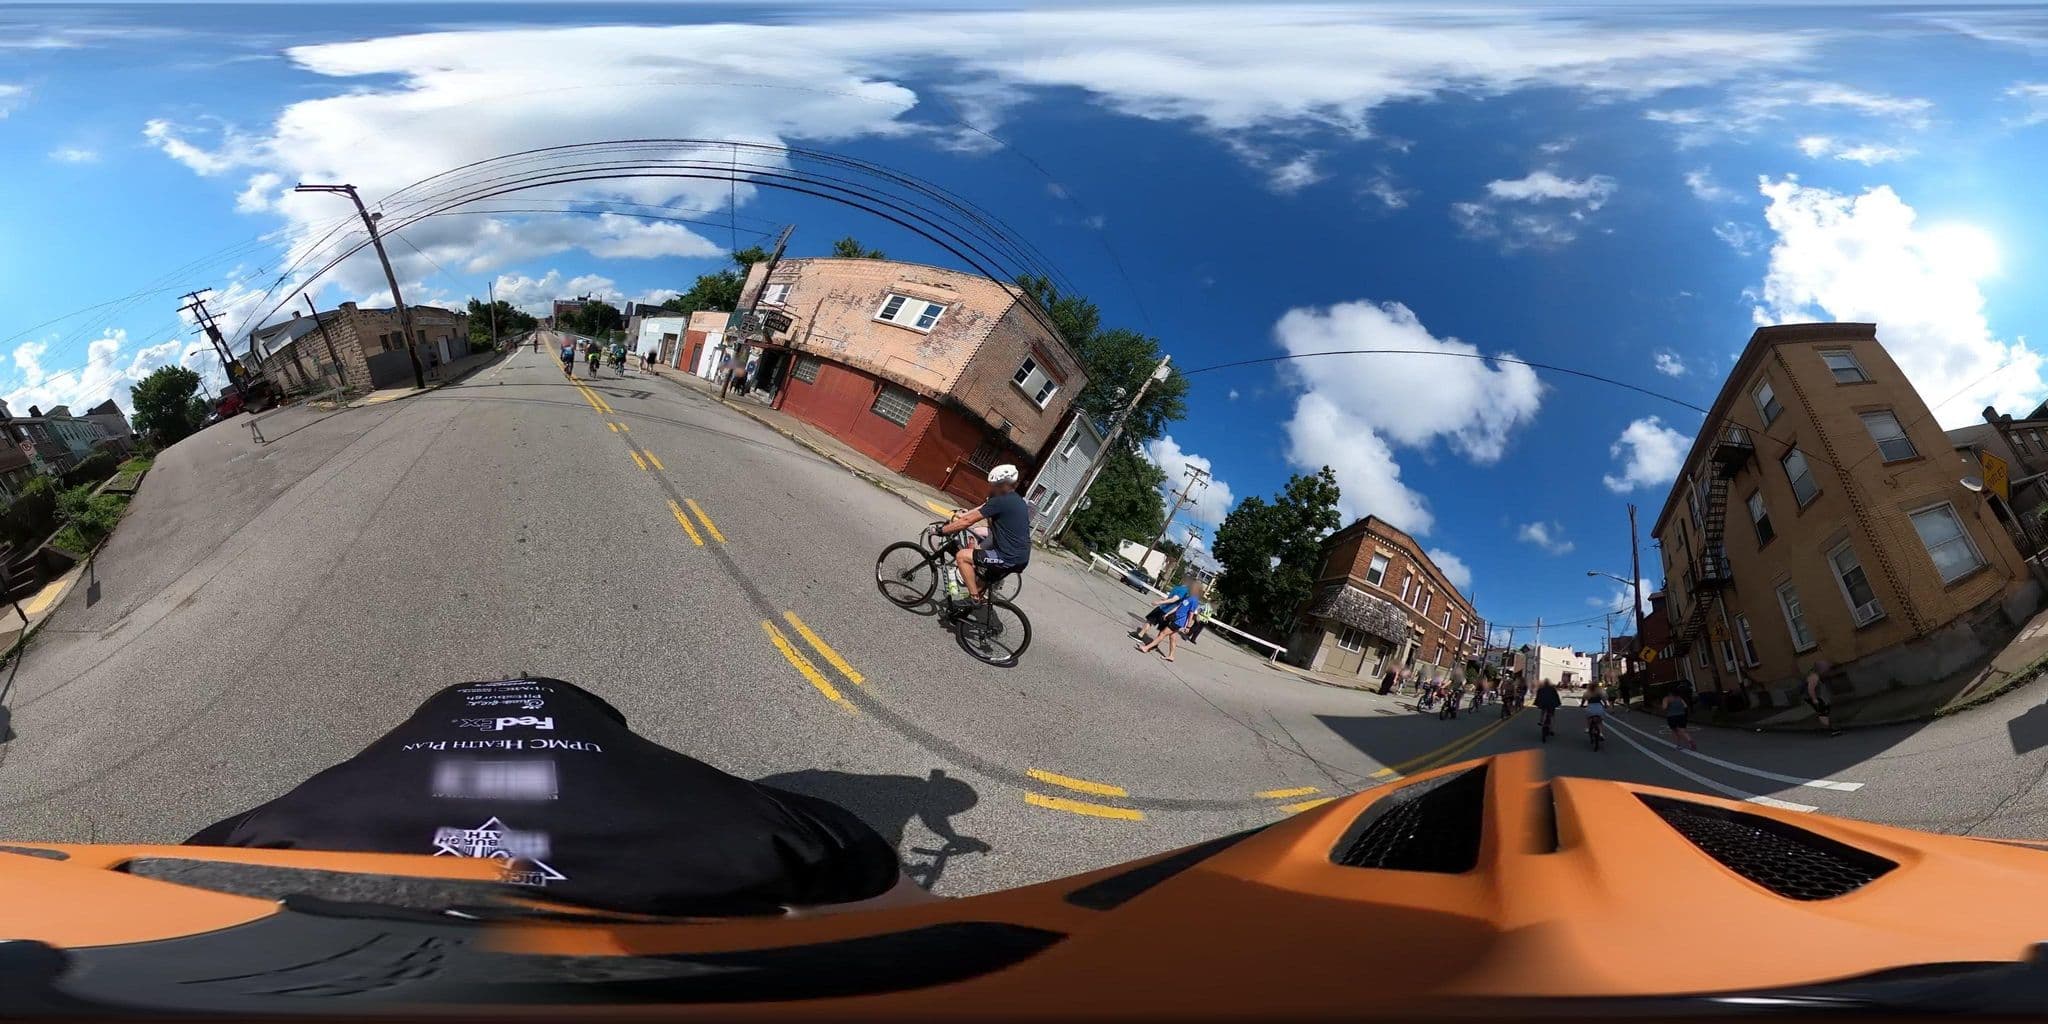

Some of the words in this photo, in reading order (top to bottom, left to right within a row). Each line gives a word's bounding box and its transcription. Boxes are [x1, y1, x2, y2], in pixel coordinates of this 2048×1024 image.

[742, 322, 755, 331] 25
[459, 716, 554, 731] FedEx
[402, 741, 447, 751] PLAN
[453, 739, 523, 750] HEALTH
[530, 739, 603, 752] UPMC
